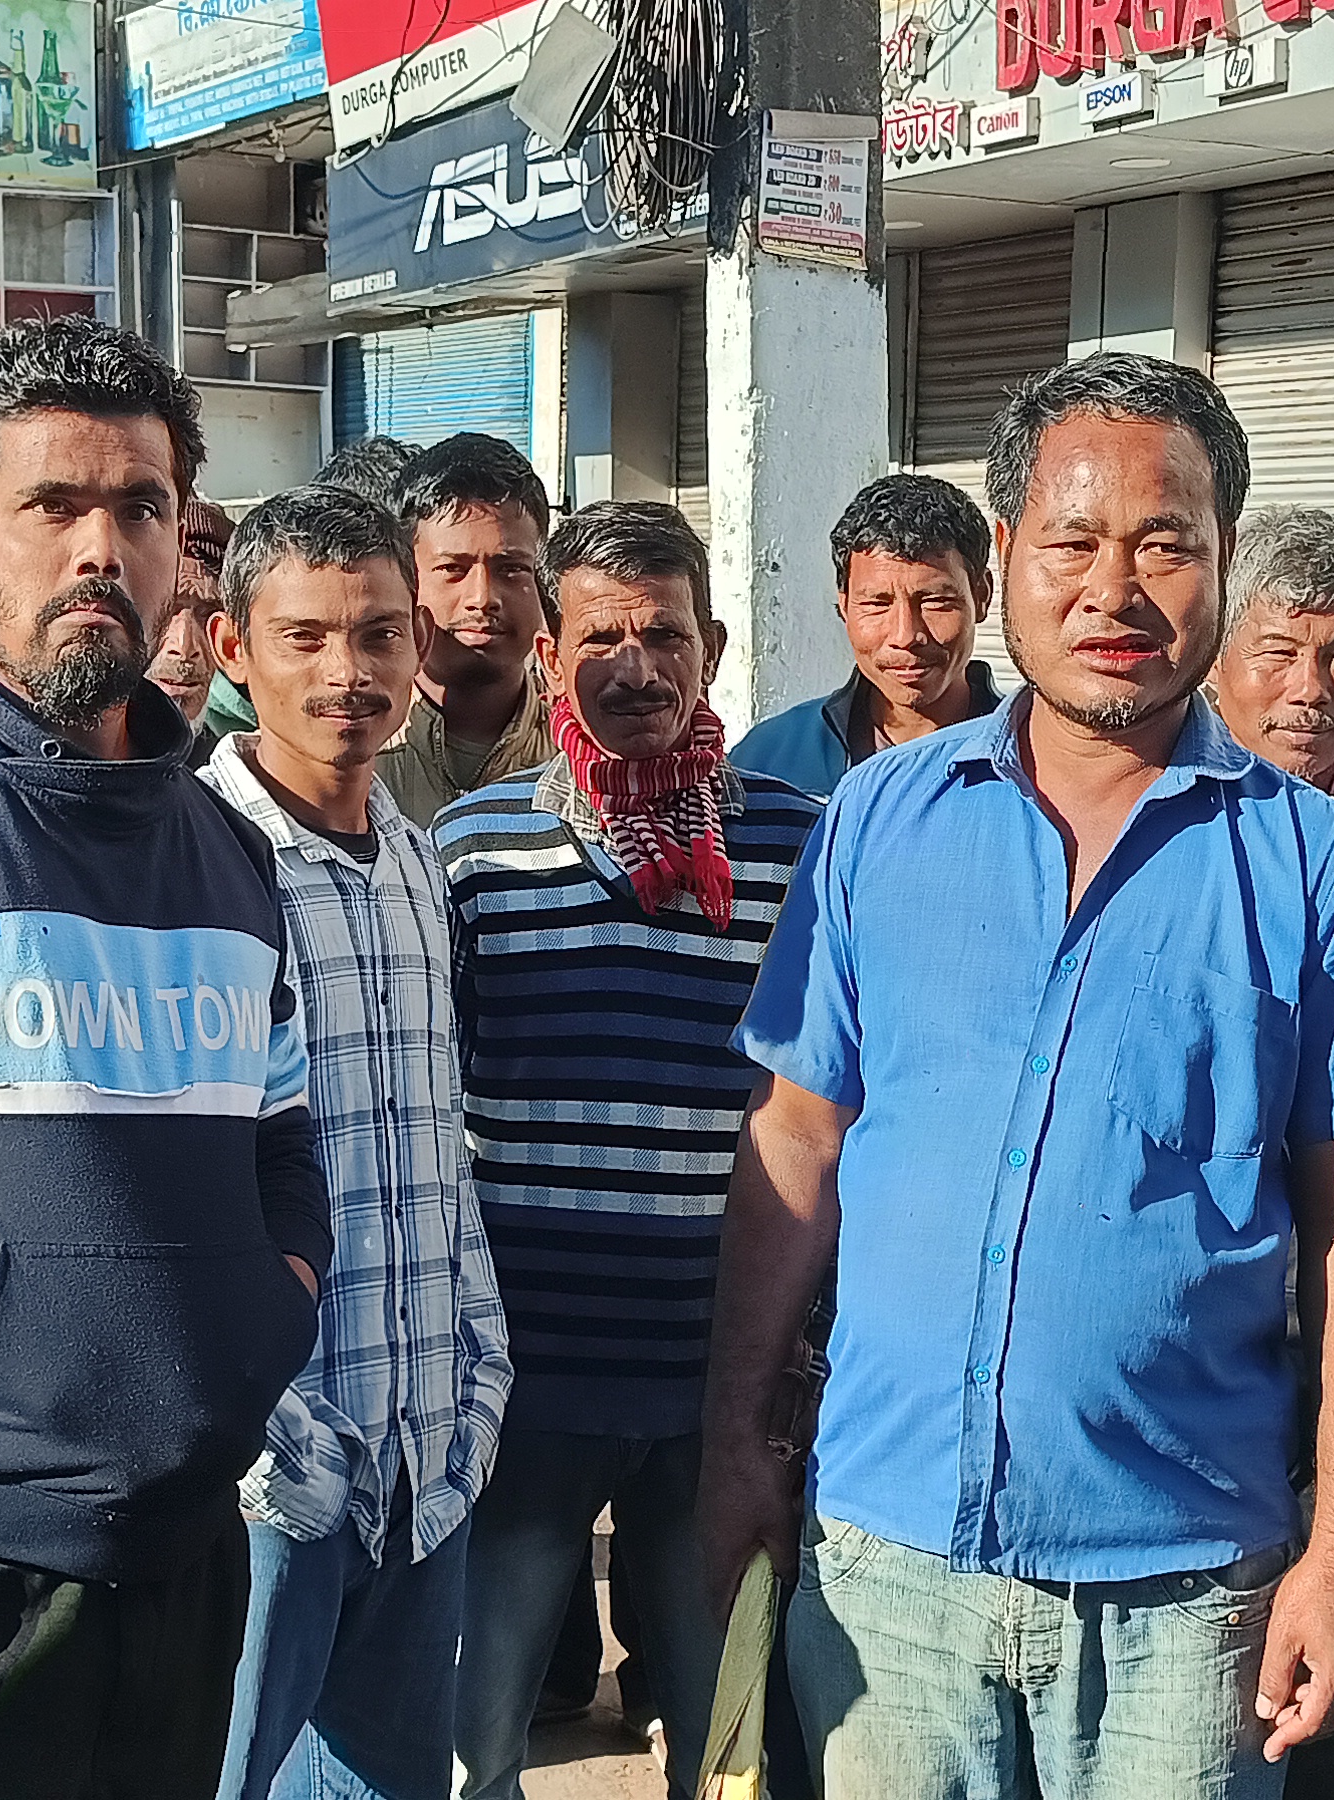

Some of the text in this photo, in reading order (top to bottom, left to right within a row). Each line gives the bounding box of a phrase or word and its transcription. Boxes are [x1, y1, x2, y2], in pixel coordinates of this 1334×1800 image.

[996, 0, 1230, 91] DURGA
[1228, 50, 1248, 87] hp
[341, 80, 388, 116] DURGA
[392, 48, 469, 95] COMPUTER
[1086, 83, 1132, 111] EPSON
[977, 110, 1019, 136] Canon
[414, 143, 589, 253] ASUS
[829, 202, 842, 224] 30
[157, 984, 269, 1053] TOW
